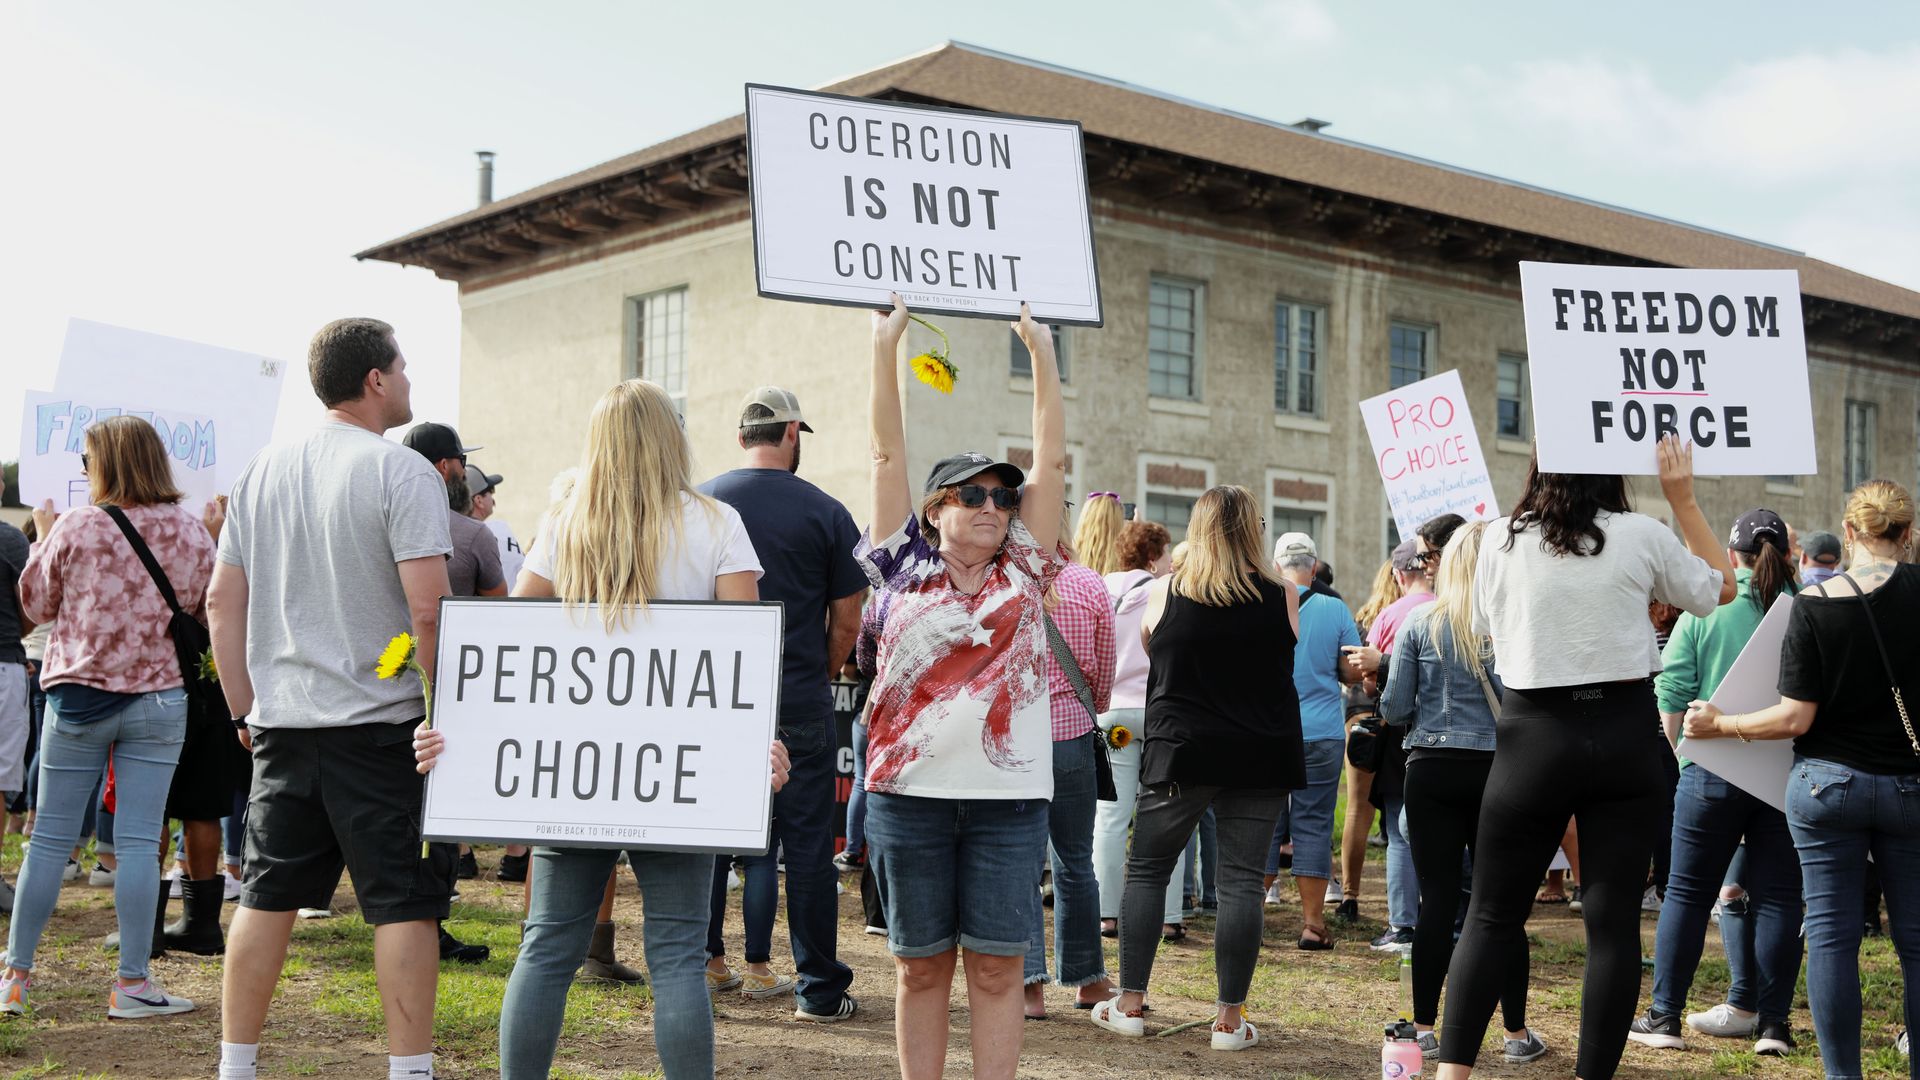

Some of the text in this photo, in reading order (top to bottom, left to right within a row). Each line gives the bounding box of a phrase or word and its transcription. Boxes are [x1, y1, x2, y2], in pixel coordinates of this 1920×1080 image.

[809, 112, 1012, 170] COERCION
[844, 175, 1000, 230] IS NOT
[833, 239, 1022, 292] CONSENT
[1552, 288, 1780, 337] FREEDOM
[1620, 348, 1706, 391] NOT
[36, 401, 216, 470] FRDOM
[1387, 396, 1454, 438] PRO
[1592, 400, 1751, 448] FORCE
[1380, 435, 1469, 480] CHOICE
[456, 644, 755, 709] PERSONAL
[494, 738, 701, 804] CHOICE
[536, 824, 647, 838] POWER BACK TO THE PEOPLE
